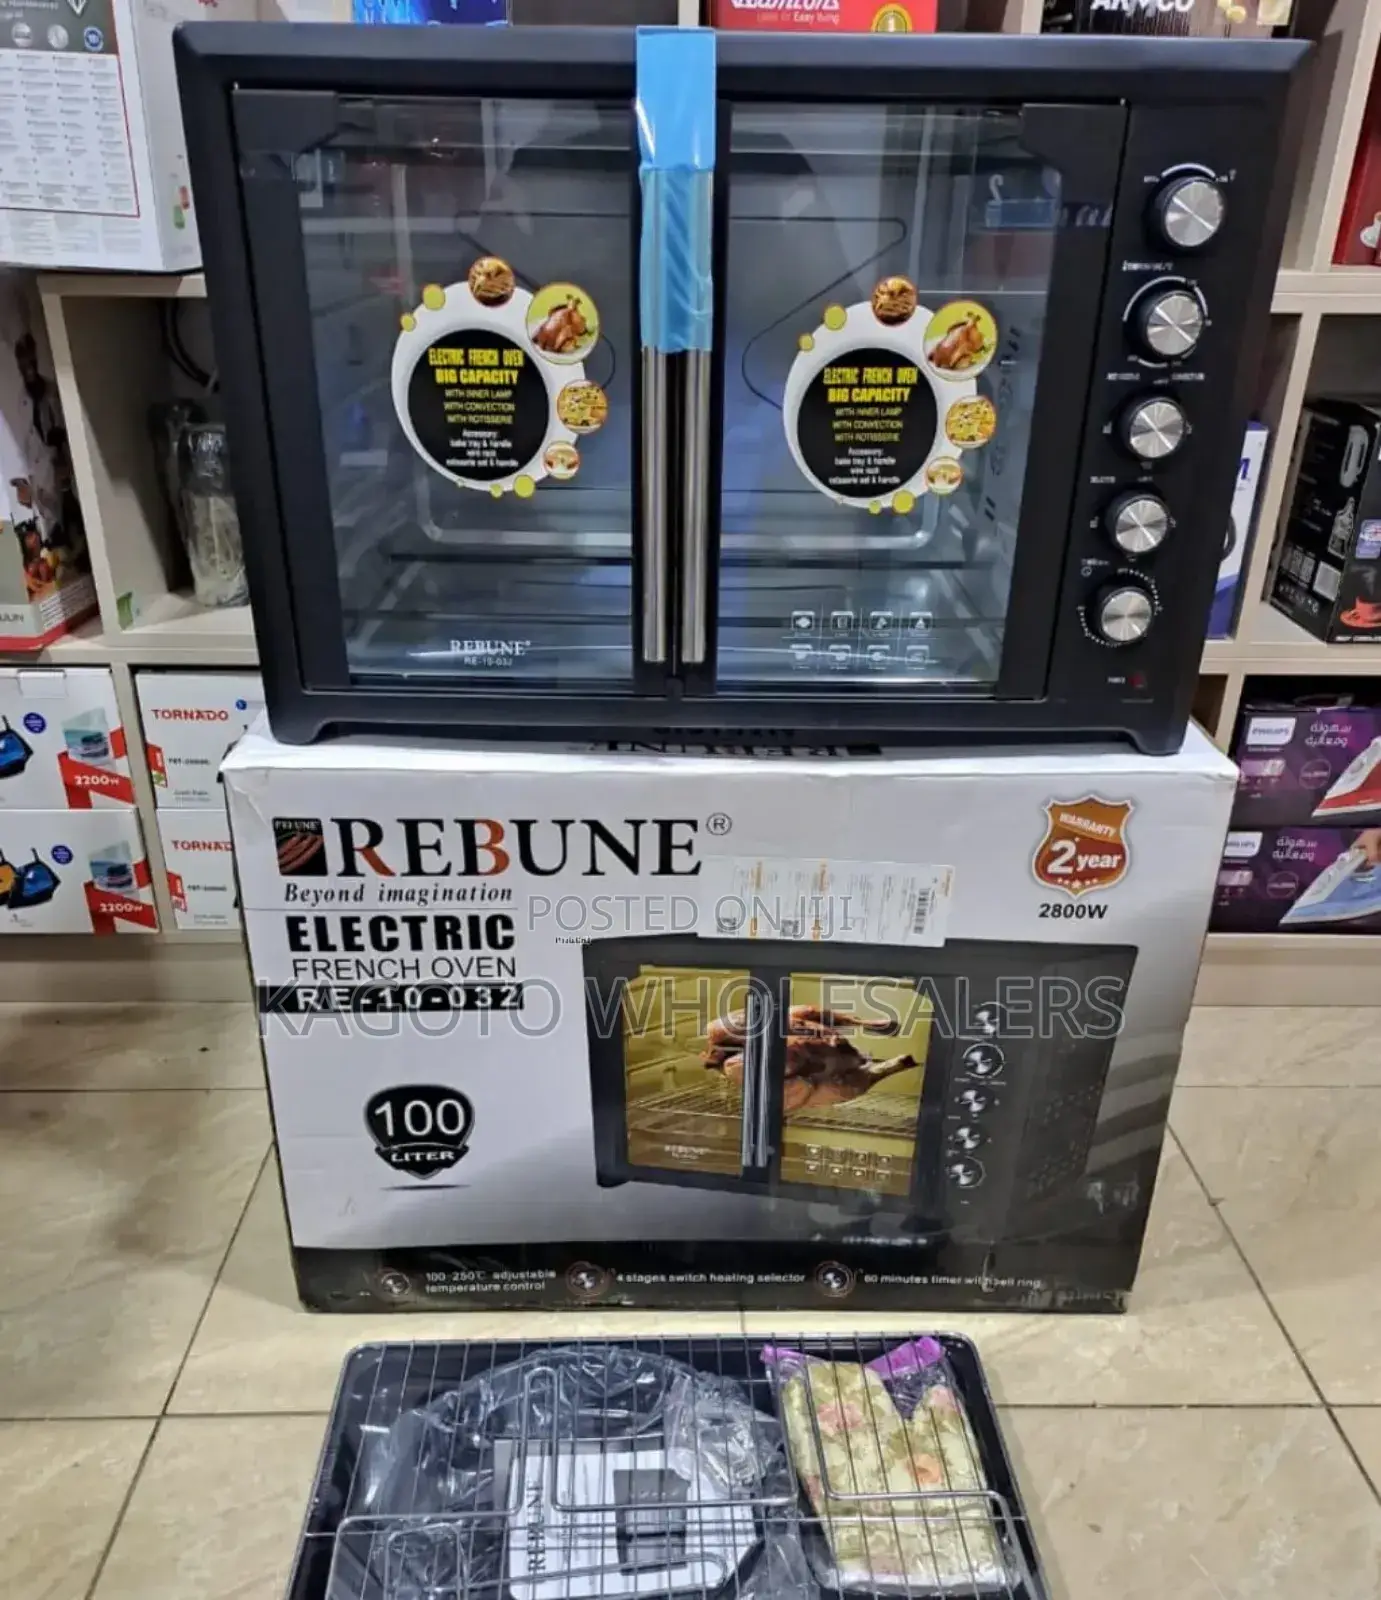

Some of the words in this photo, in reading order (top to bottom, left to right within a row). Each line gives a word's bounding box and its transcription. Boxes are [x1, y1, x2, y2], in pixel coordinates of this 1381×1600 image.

[436, 368, 458, 384] BIG
[460, 369, 518, 385] CAPACITY
[445, 389, 464, 398] WITH
[828, 388, 849, 402] BIG
[852, 387, 910, 402] CAPACITY
[444, 402, 463, 410] WITH
[464, 402, 515, 411] CONVECTION
[835, 407, 855, 416] WITH
[832, 420, 852, 429] WITH
[853, 420, 903, 429] CONVECTION
[450, 639, 526, 657] REBUNE
[150, 708, 229, 721] TORNADO
[331, 817, 703, 878] REBUNE
[1047, 839, 1076, 875] 2
[1076, 853, 1122, 873] year
[284, 883, 365, 907] Beyond
[378, 882, 513, 906] imagination
[1038, 902, 1108, 920] 2800W
[285, 914, 515, 953] ELECTRIC
[292, 957, 421, 981] FRENCH
[430, 956, 517, 980] OVEN
[296, 985, 518, 1011] RE-10-032
[374, 1099, 465, 1137] 100
[390, 1150, 455, 1163] LITER
[492, 1269, 557, 1282] adjustable
[626, 1274, 667, 1284] stages
[668, 1272, 707, 1283] switch
[709, 1272, 754, 1285] heating
[757, 1273, 806, 1284] selector
[880, 1274, 929, 1285] minutes
[931, 1275, 962, 1285] timer
[1017, 1278, 1043, 1290] ring
[425, 1283, 501, 1295] temperature
[503, 1281, 546, 1293] control
